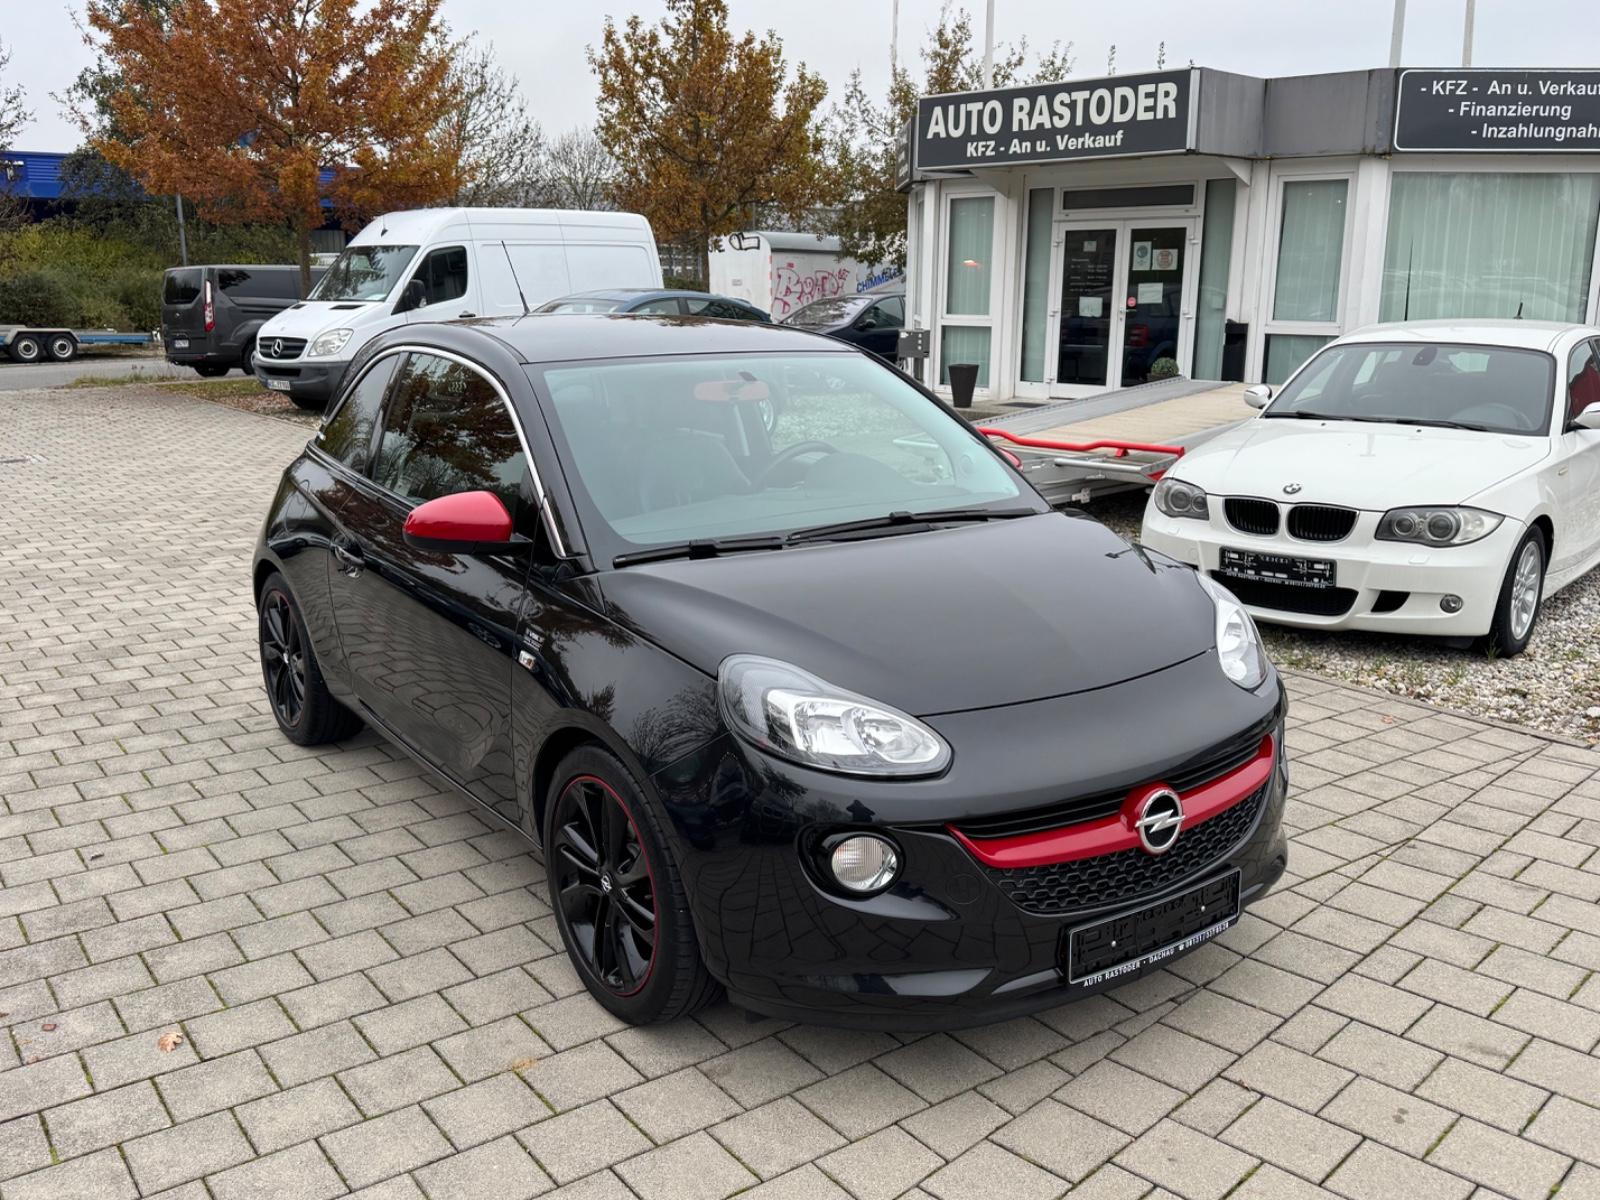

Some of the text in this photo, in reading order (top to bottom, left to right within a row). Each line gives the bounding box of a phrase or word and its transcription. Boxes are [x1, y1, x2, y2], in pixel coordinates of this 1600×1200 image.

[1432, 80, 1468, 95] KFZ
[1487, 80, 1511, 95] An
[1517, 82, 1532, 95] u.
[926, 82, 1178, 139] AUTO RASTODER
[1459, 102, 1572, 120] Finanzierung
[1482, 123, 1600, 141] Inzahlungnah
[967, 140, 995, 157] KFZ
[1009, 138, 1031, 155] An
[1036, 140, 1050, 153] u.
[1056, 130, 1124, 150] Verkauf
[1083, 975, 1102, 987] AUTO
[1105, 960, 1141, 980] RASTODER
